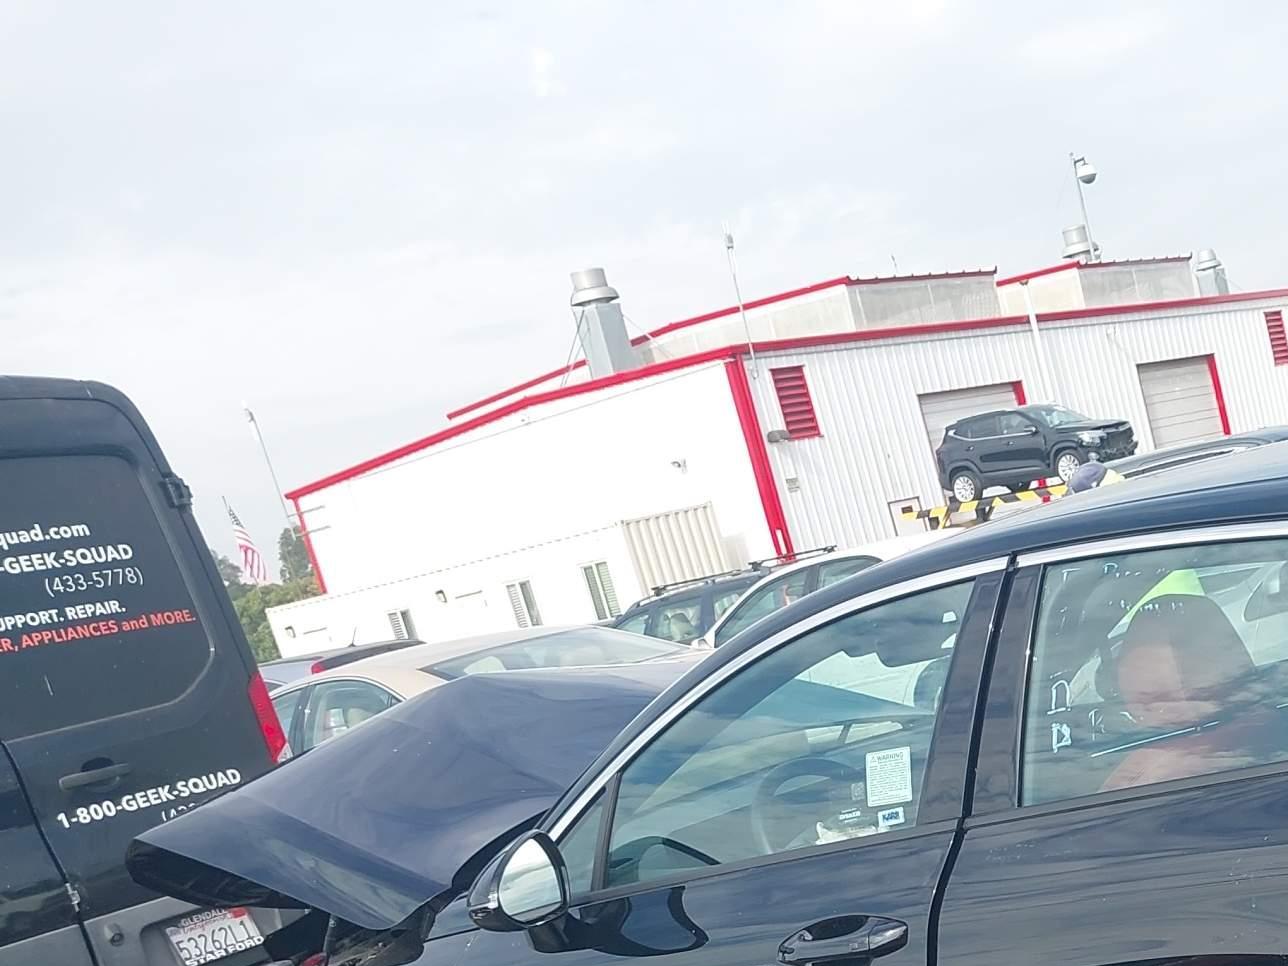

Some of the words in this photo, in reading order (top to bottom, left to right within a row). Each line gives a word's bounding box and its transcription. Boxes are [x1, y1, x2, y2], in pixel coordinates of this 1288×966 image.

[45, 567, 144, 597] (433-5778)
[65, 600, 127, 621] REPAIR.
[0, 637, 19, 653] R,
[22, 620, 118, 648] APPLIANCES
[122, 615, 149, 632] and
[151, 609, 197, 627] MORE.
[57, 768, 241, 829] 1-800-GEEK-SQUAD
[175, 920, 253, 960] 53262L1
[229, 936, 264, 954] FORD
